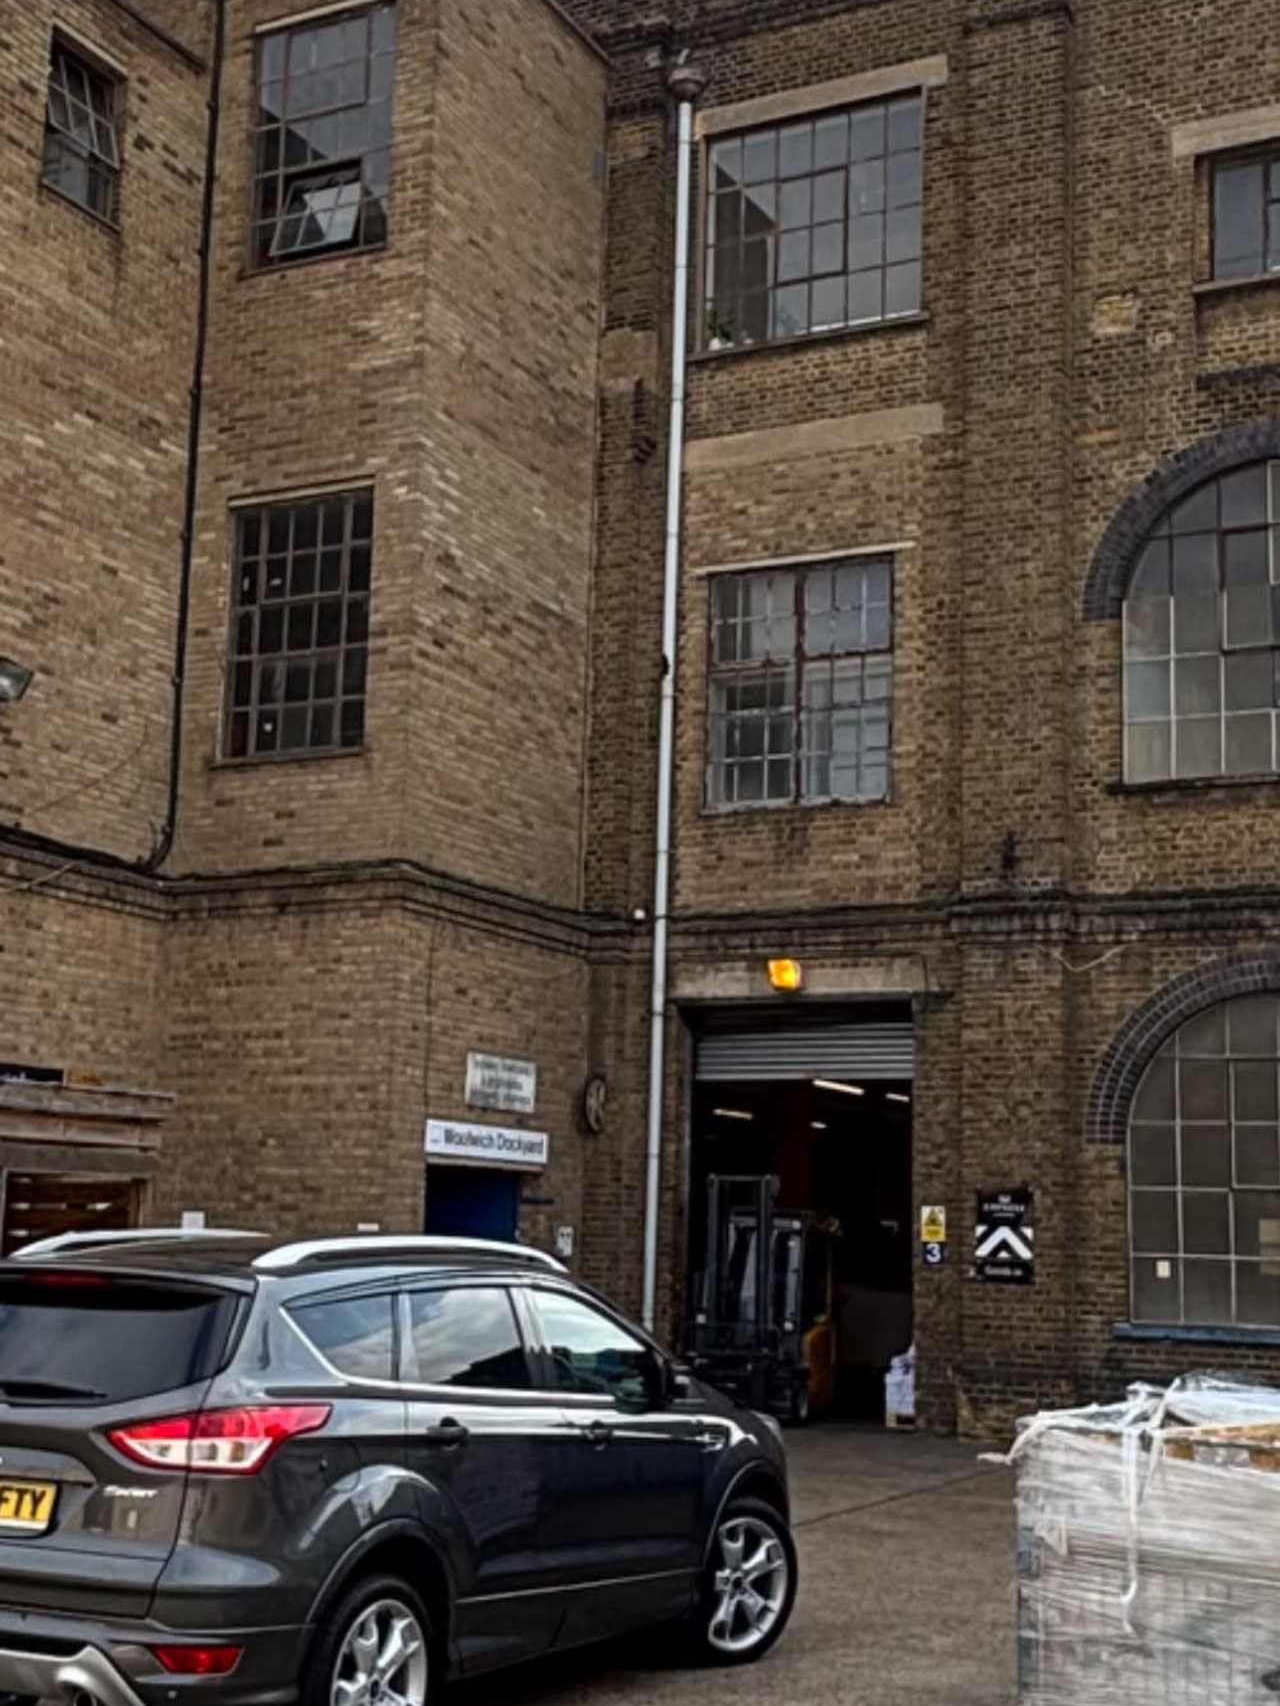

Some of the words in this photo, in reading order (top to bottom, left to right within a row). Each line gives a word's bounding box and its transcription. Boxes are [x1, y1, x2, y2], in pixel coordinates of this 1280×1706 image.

[443, 1128, 494, 1149] Woolwich
[496, 1132, 544, 1155] Dockyard
[925, 1243, 941, 1263] 3
